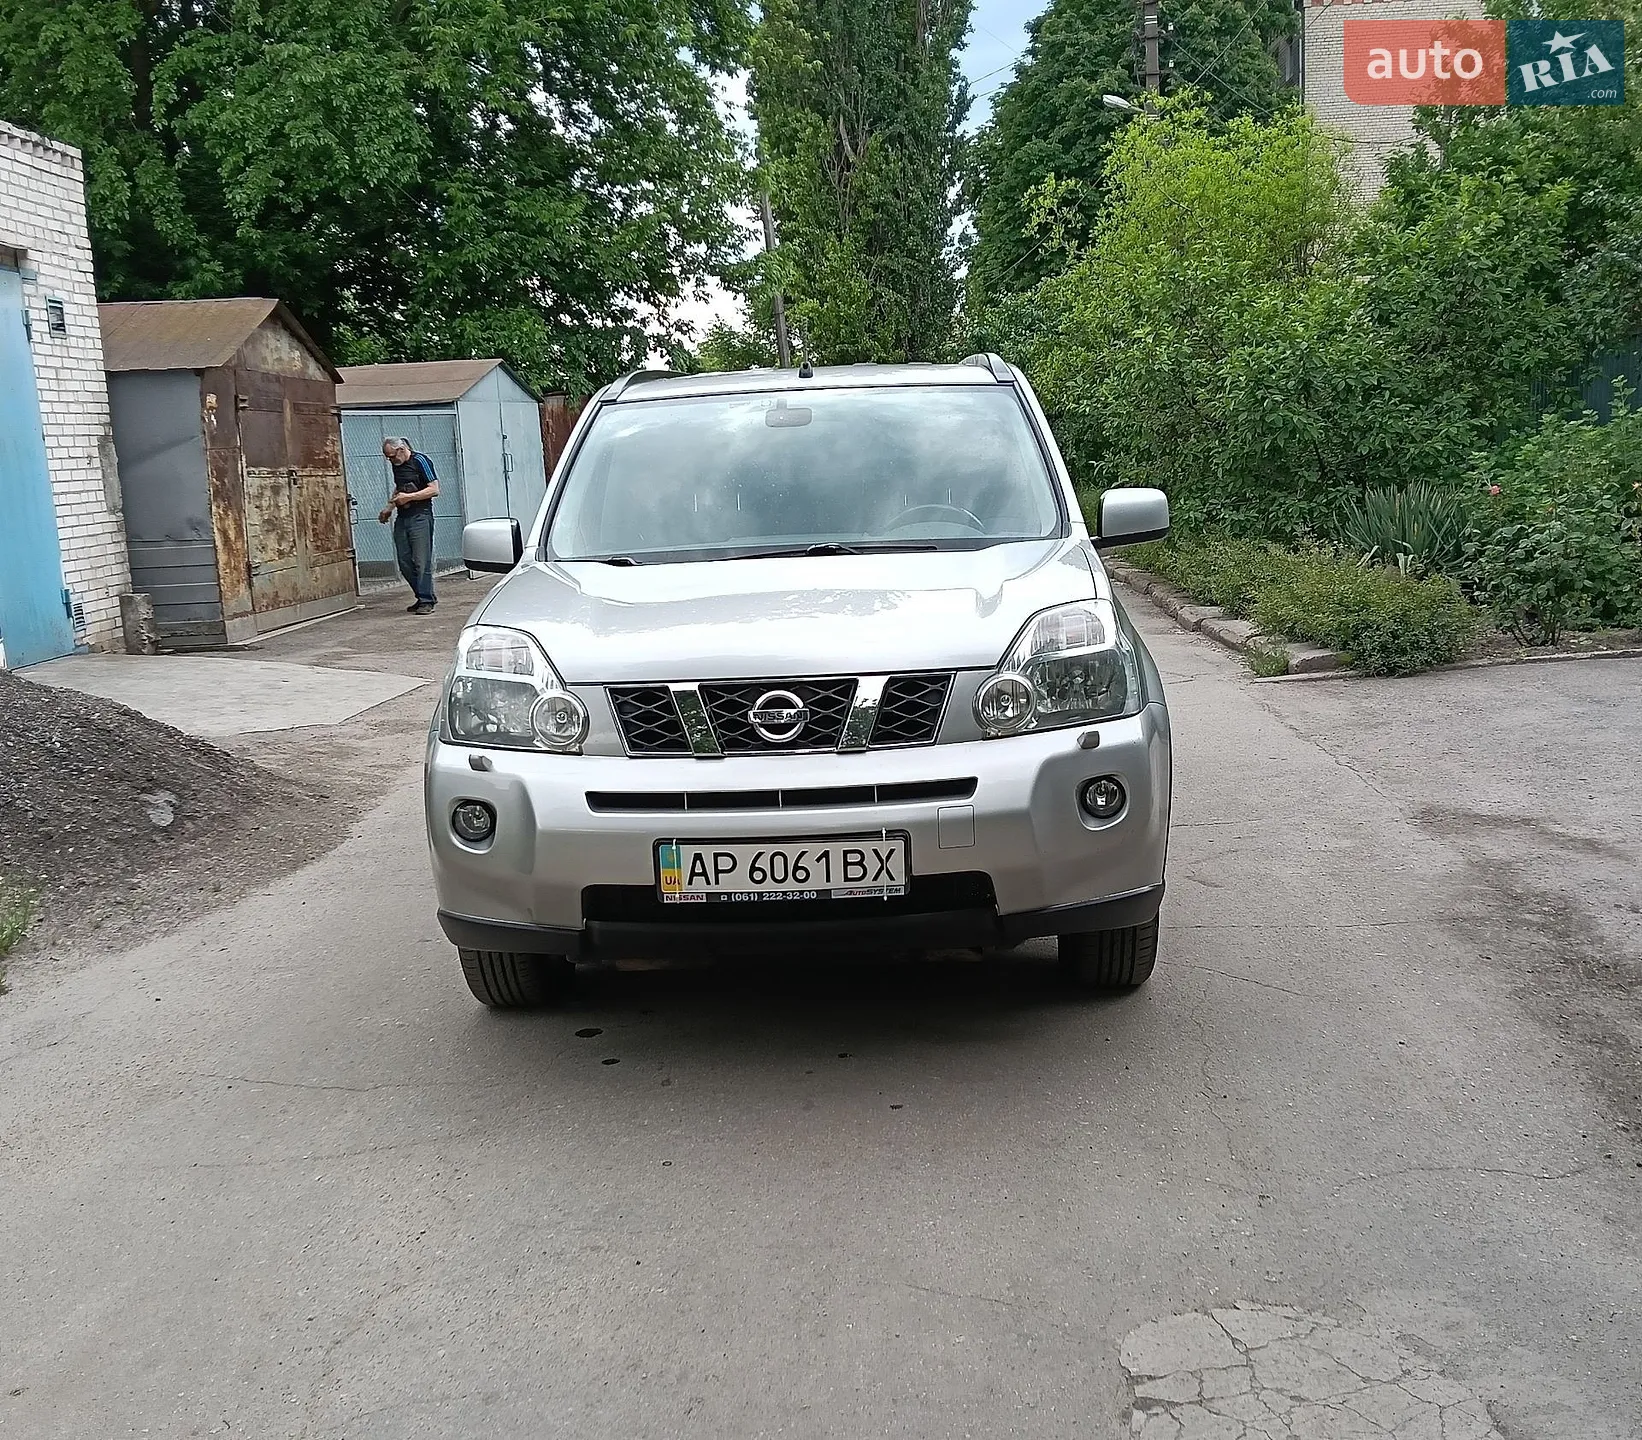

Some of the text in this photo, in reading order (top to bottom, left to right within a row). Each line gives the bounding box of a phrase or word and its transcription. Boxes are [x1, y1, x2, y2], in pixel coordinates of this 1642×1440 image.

[752, 711, 804, 721] NISSAN
[687, 847, 896, 886] AP 6061 BX
[664, 876, 680, 886] UA
[665, 894, 704, 902] NISSAN
[731, 891, 758, 901] (061)
[762, 890, 817, 900] 222-32-00
